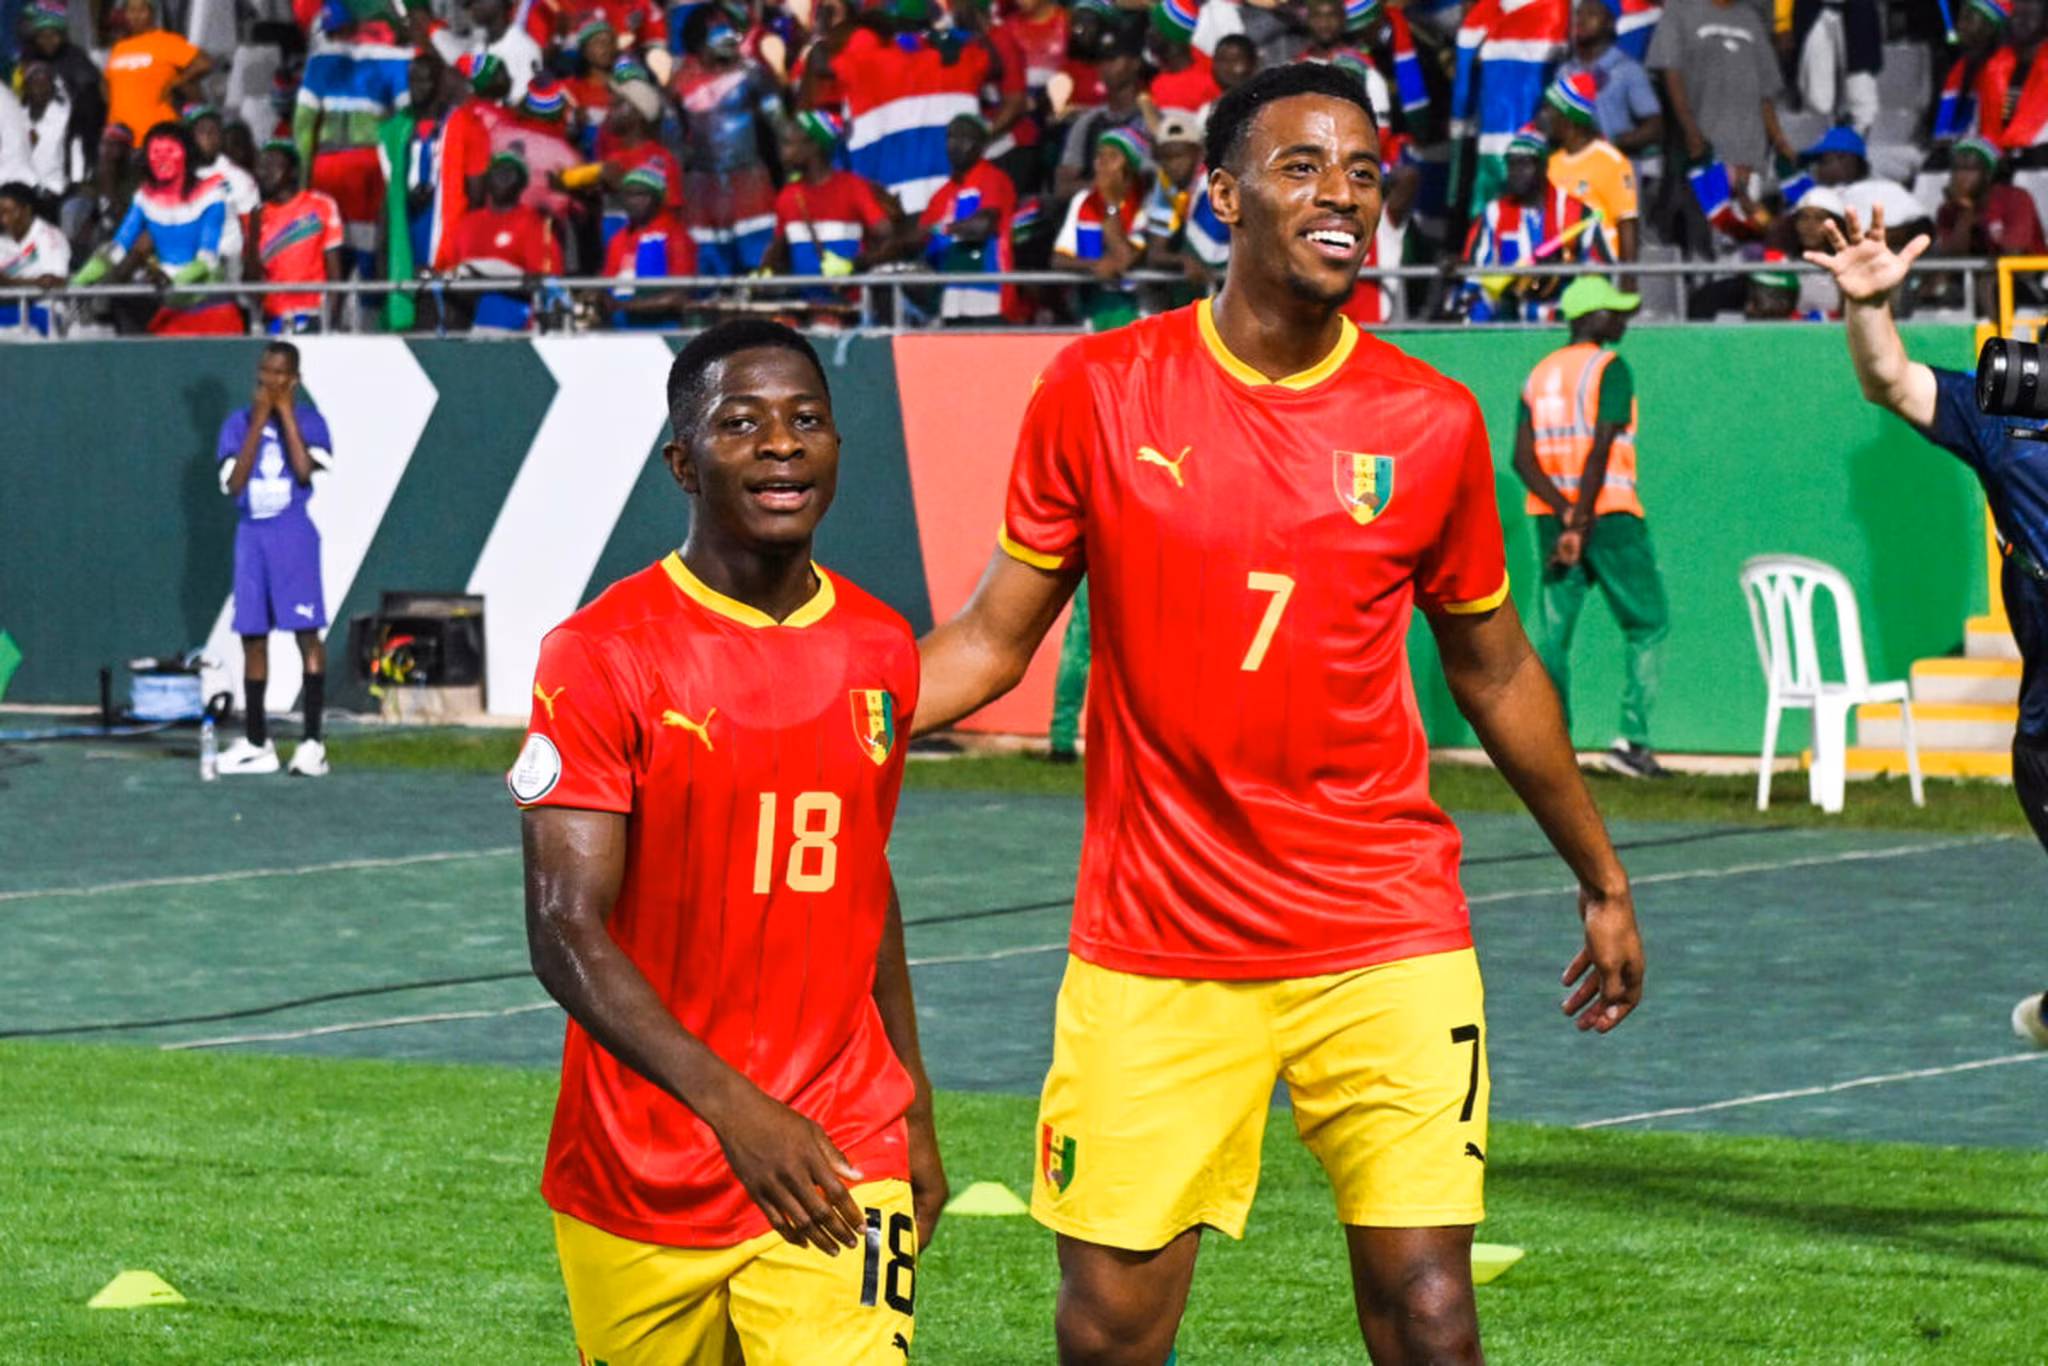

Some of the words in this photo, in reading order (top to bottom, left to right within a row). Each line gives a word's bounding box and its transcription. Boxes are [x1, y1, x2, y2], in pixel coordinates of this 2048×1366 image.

[1241, 571, 1295, 670] 7
[753, 791, 841, 893] 18
[1450, 1024, 1479, 1122] 7
[860, 1207, 915, 1316] 18
